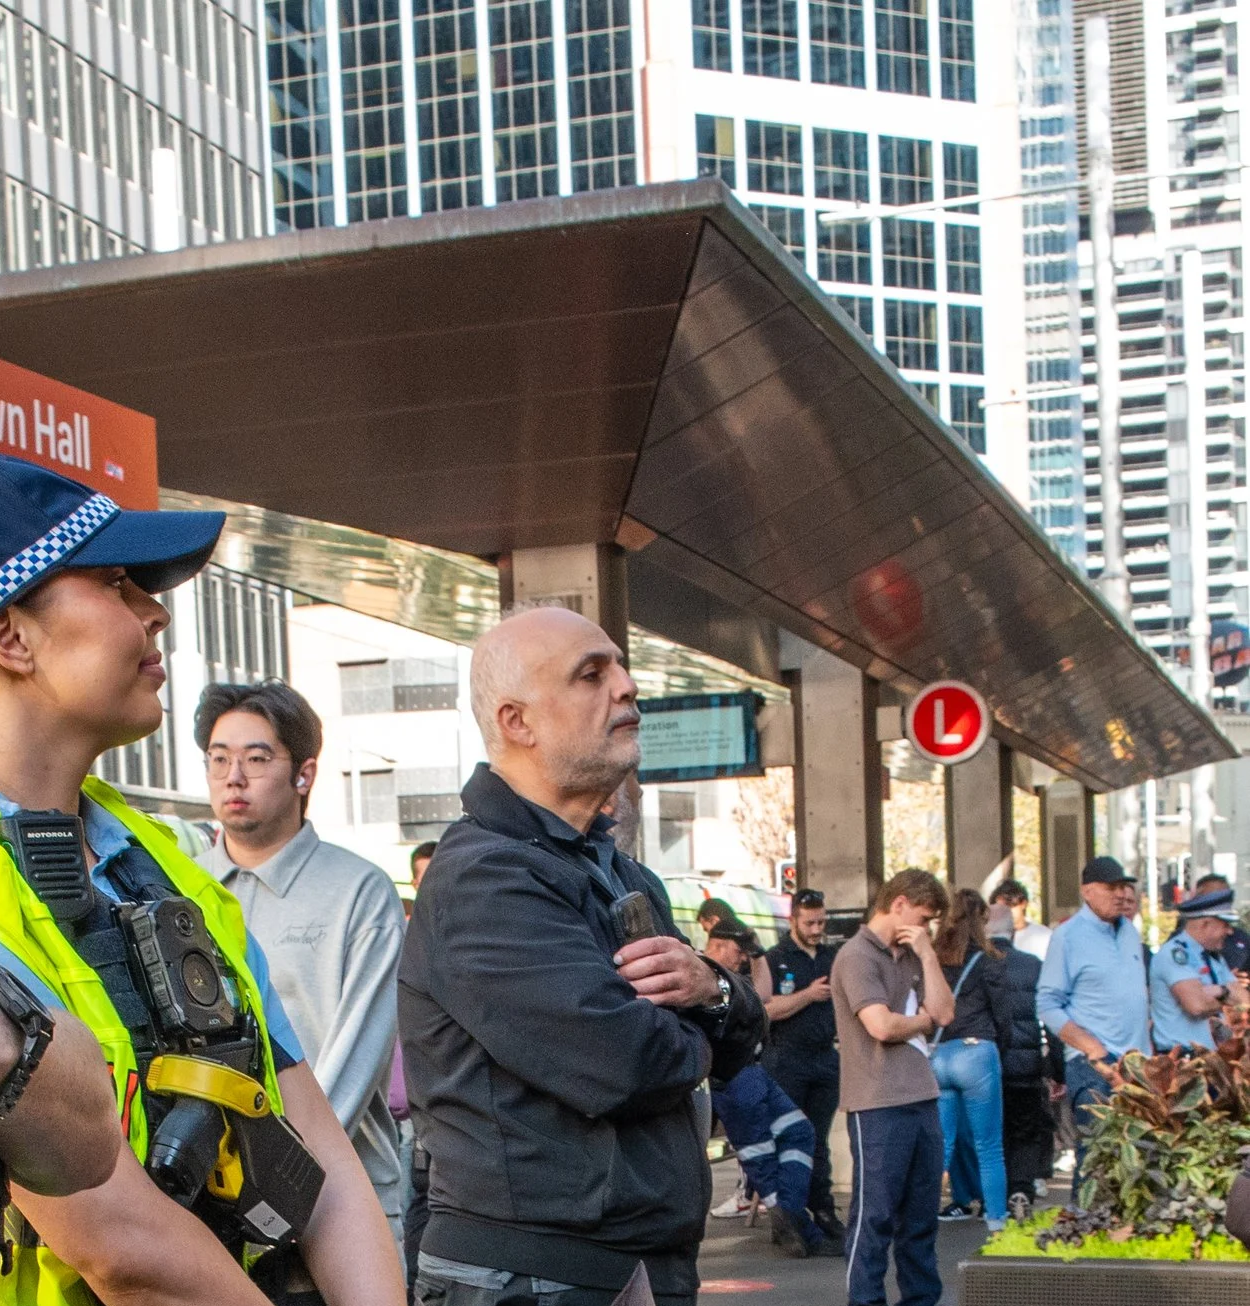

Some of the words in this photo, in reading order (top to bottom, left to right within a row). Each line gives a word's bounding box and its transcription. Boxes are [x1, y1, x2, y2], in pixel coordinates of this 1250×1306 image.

[33, 399, 91, 471] Hall
[934, 698, 963, 745] L
[27, 831, 73, 839] MOTOROLA
